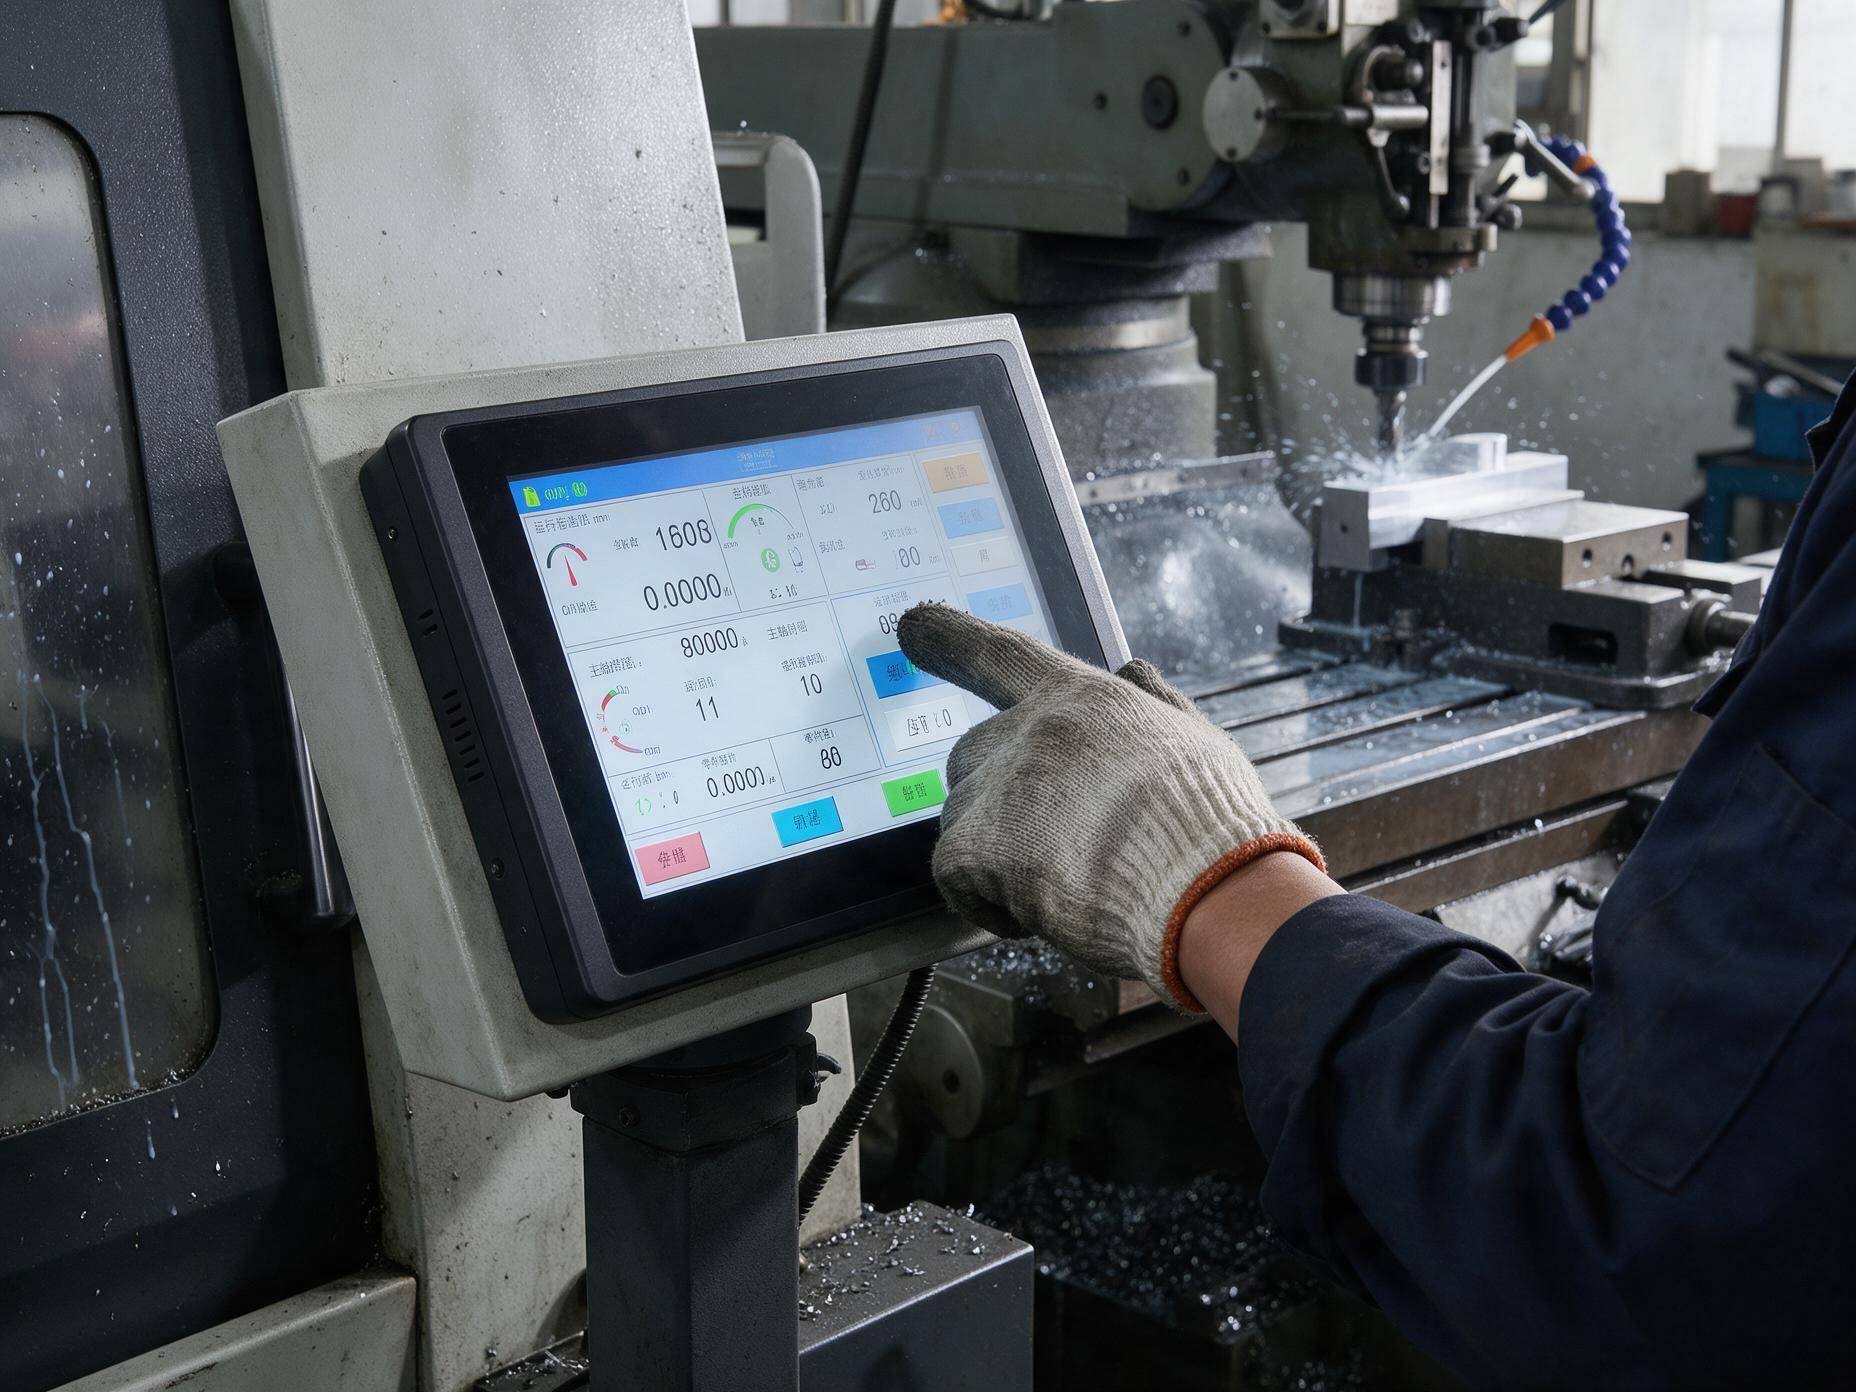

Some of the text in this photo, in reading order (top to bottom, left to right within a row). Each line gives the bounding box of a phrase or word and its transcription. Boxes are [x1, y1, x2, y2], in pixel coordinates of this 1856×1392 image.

[868, 489, 902, 514] 260
[655, 518, 714, 551] 1608
[643, 573, 722, 611] 0.0000
[680, 627, 739, 659] 80000
[800, 673, 823, 697] 10
[695, 695, 719, 722] 11
